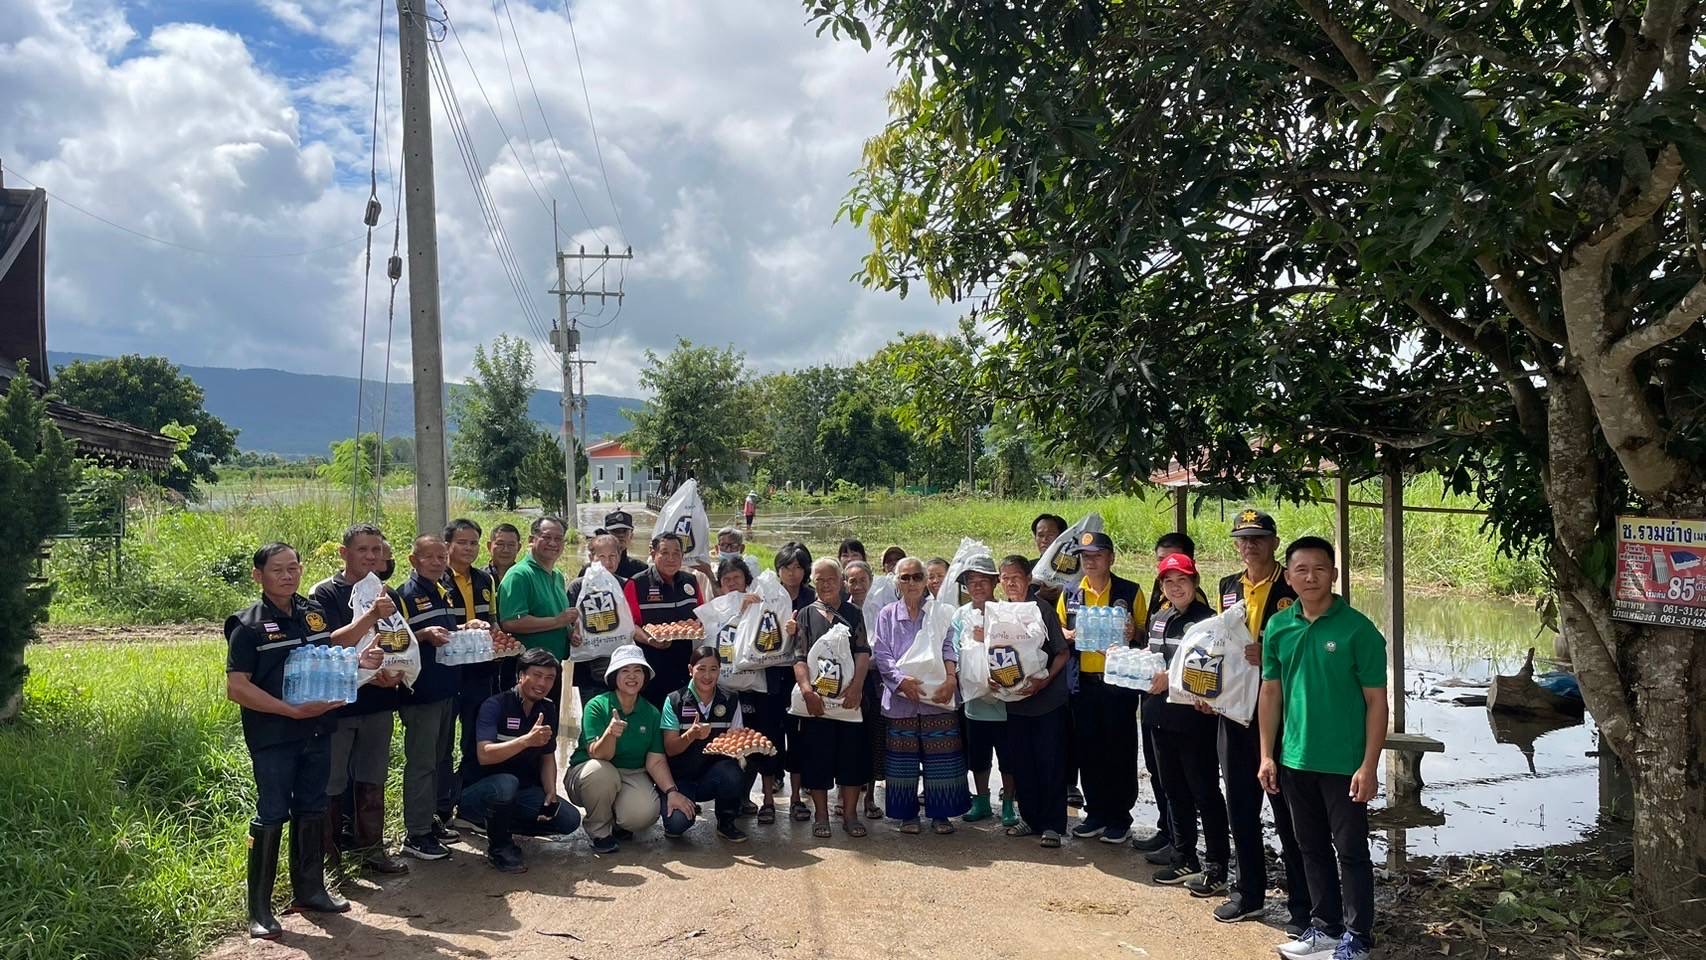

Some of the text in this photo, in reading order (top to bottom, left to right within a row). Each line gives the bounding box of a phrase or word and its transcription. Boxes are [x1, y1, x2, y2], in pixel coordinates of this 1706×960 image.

[1622, 521, 1692, 543] ช.รวมช่าง
[1667, 576, 1696, 602] 85
